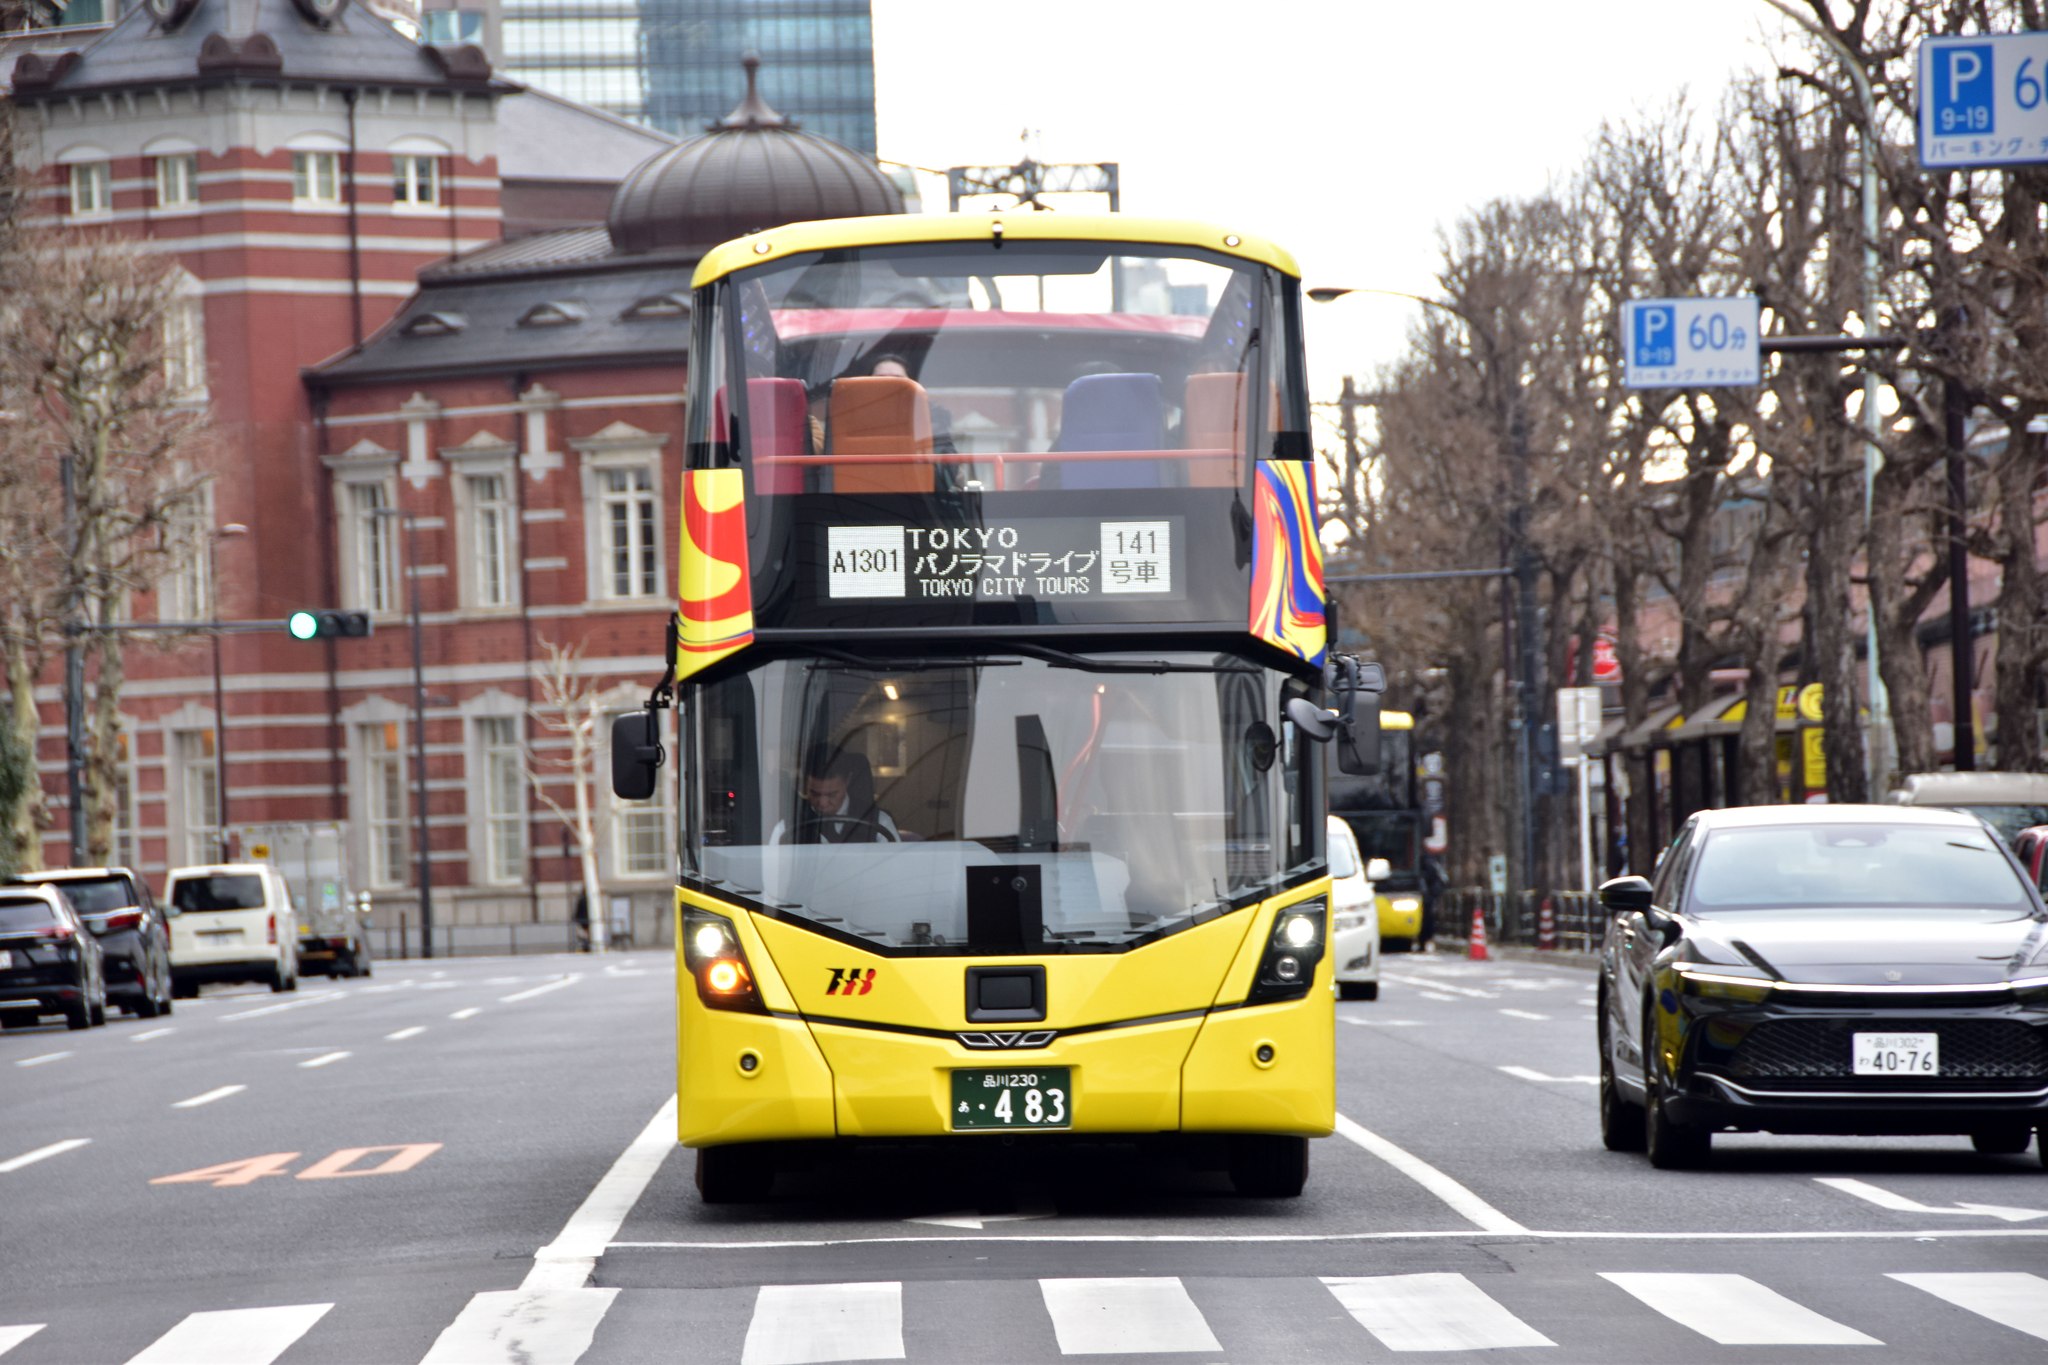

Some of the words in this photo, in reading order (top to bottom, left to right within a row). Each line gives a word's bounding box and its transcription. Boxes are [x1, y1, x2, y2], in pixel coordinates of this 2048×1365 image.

[1949, 50, 1982, 104] P
[2015, 56, 2048, 112] 6
[1941, 105, 1989, 131] 9-19
[1644, 308, 1668, 346] P
[905, 527, 1018, 550] TOKYO
[1116, 530, 1156, 554] 141
[833, 549, 898, 573] A1301
[913, 550, 1100, 576] パノラマドライブ
[1109, 560, 1159, 584] 号車
[919, 578, 973, 597] TOKYO
[982, 577, 1026, 595] CITY
[1036, 576, 1090, 595] TOURS
[1873, 1051, 1932, 1071] 40-76
[148, 1142, 444, 1188] 40
